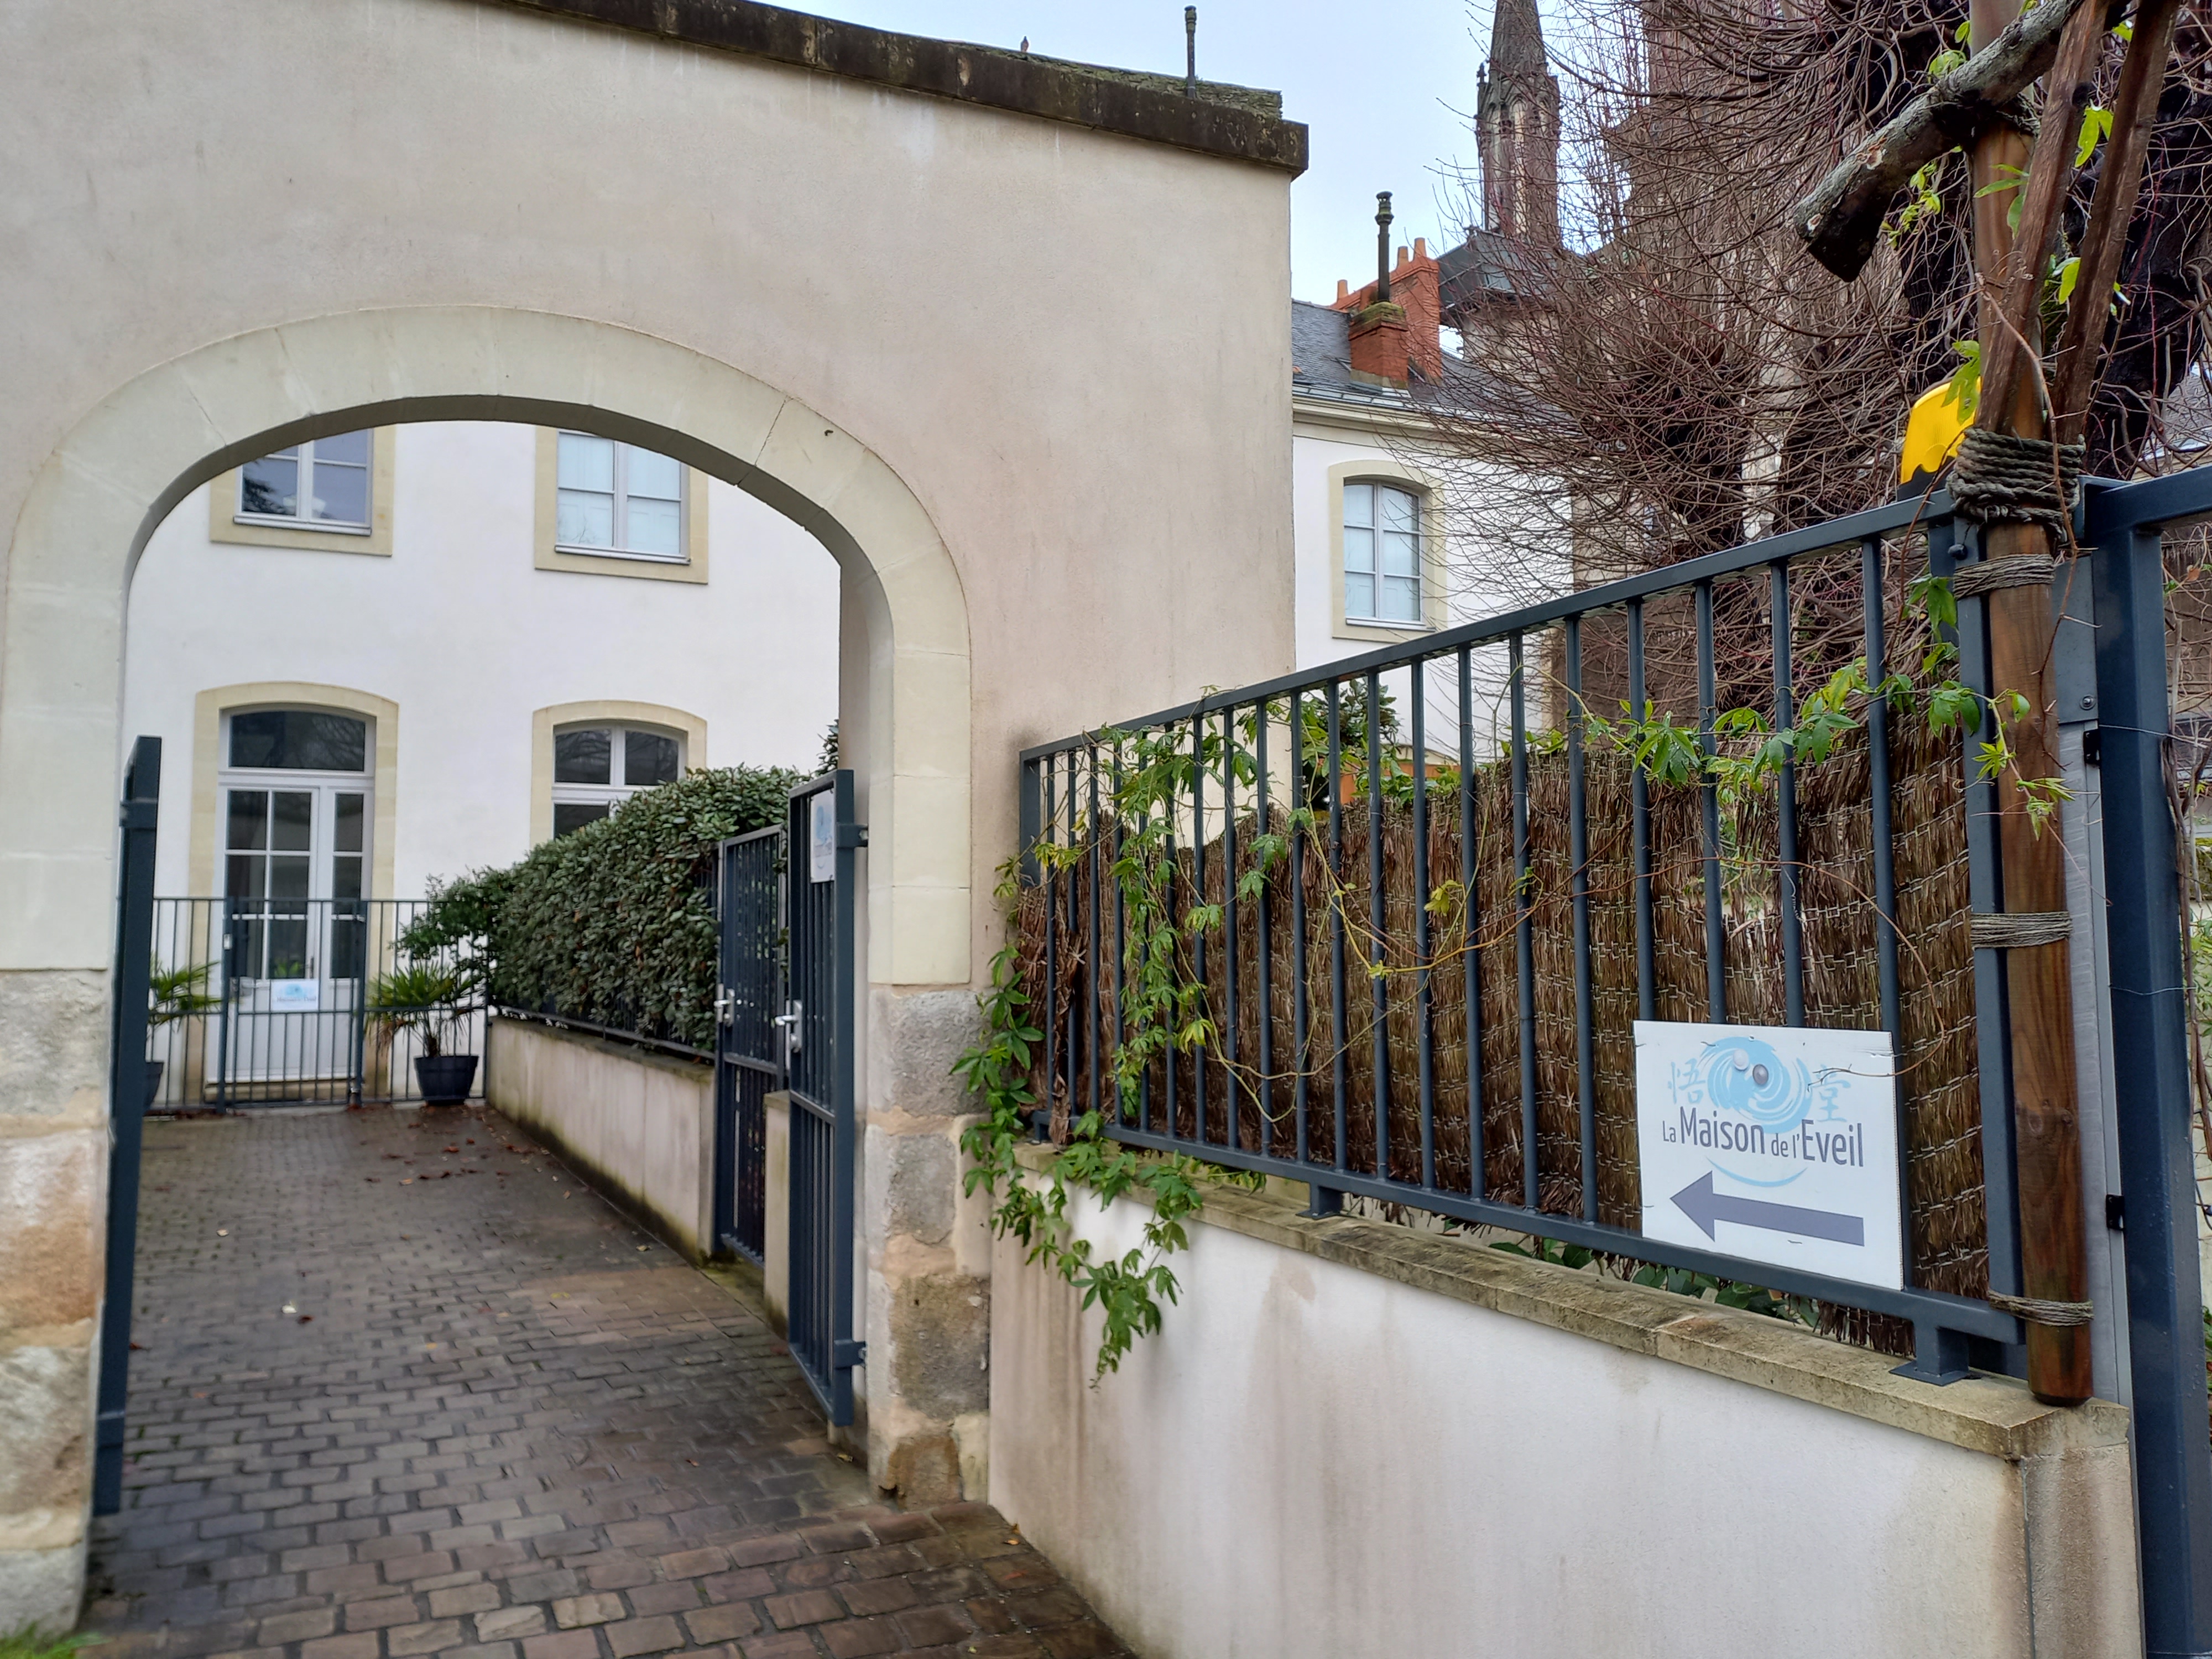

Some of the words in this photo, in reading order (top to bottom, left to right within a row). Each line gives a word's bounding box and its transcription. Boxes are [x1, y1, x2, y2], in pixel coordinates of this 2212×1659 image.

[1667, 1058, 1707, 1105] 悟
[1662, 1120, 1677, 1143] La
[1680, 1106, 1765, 1155] Maison
[1771, 1133, 1790, 1157] de
